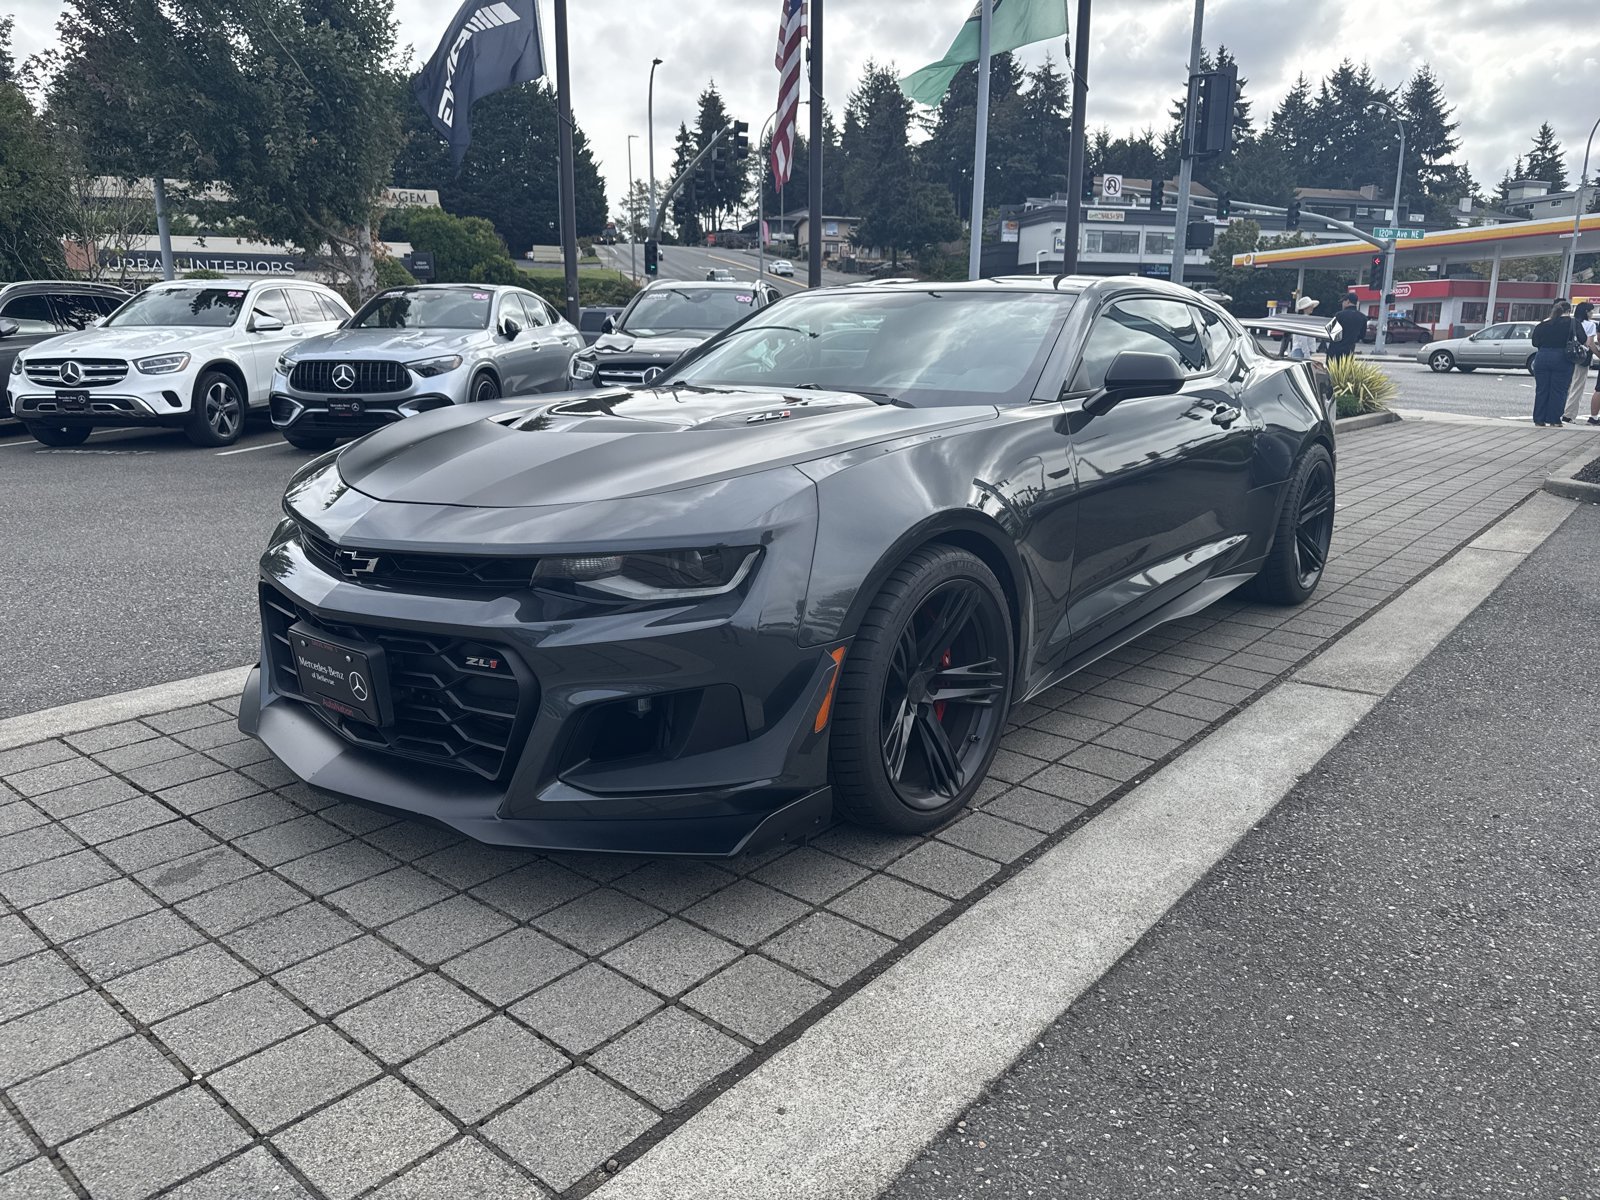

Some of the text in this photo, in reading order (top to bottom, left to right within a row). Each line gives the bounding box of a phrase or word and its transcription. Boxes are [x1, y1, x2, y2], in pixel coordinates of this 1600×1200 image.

[1396, 230, 1408, 238] Ave
[1411, 230, 1420, 239] NE
[189, 258, 295, 276] INTERIORS
[746, 410, 791, 422] ZL1
[298, 655, 345, 680] Mercedes-Benz
[465, 656, 498, 669] ZL1
